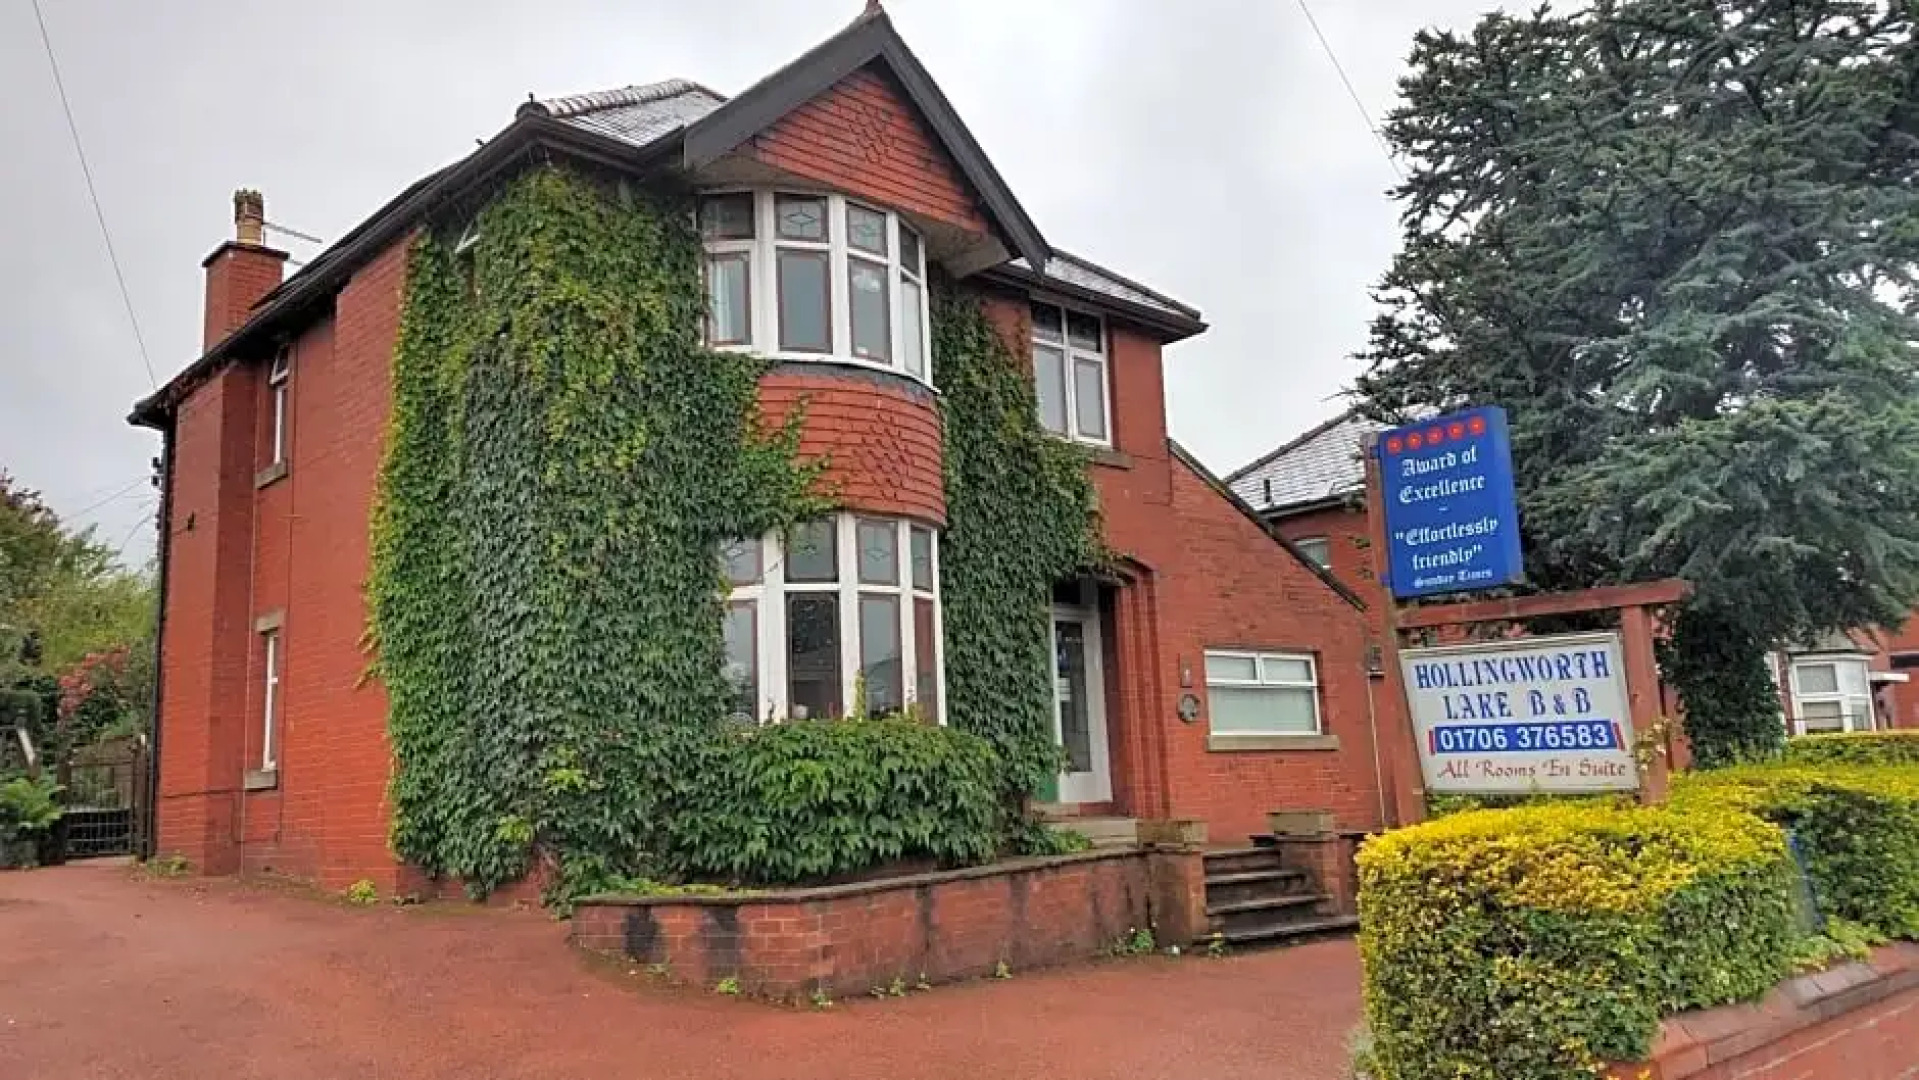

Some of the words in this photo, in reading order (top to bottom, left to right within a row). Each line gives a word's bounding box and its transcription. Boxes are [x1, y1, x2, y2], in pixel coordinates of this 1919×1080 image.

[1401, 452, 1457, 477] Award
[1461, 444, 1478, 463] of
[1399, 475, 1485, 503] Excellence
[1395, 516, 1499, 546] "Effortlessly
[1412, 544, 1483, 570] friendly"
[1414, 574, 1455, 588] Sunday
[1457, 568, 1493, 582] Times
[1414, 650, 1611, 689] HOLLINGWORTH
[1443, 691, 1514, 720] LAKE
[1529, 689, 1546, 717] B
[1553, 693, 1567, 715] &
[1572, 687, 1592, 714] B
[1440, 728, 1508, 750] 01706
[1516, 724, 1610, 749] 376583
[1437, 759, 1469, 779] All
[1475, 759, 1536, 778] Rooms
[1578, 757, 1627, 777] Suite
